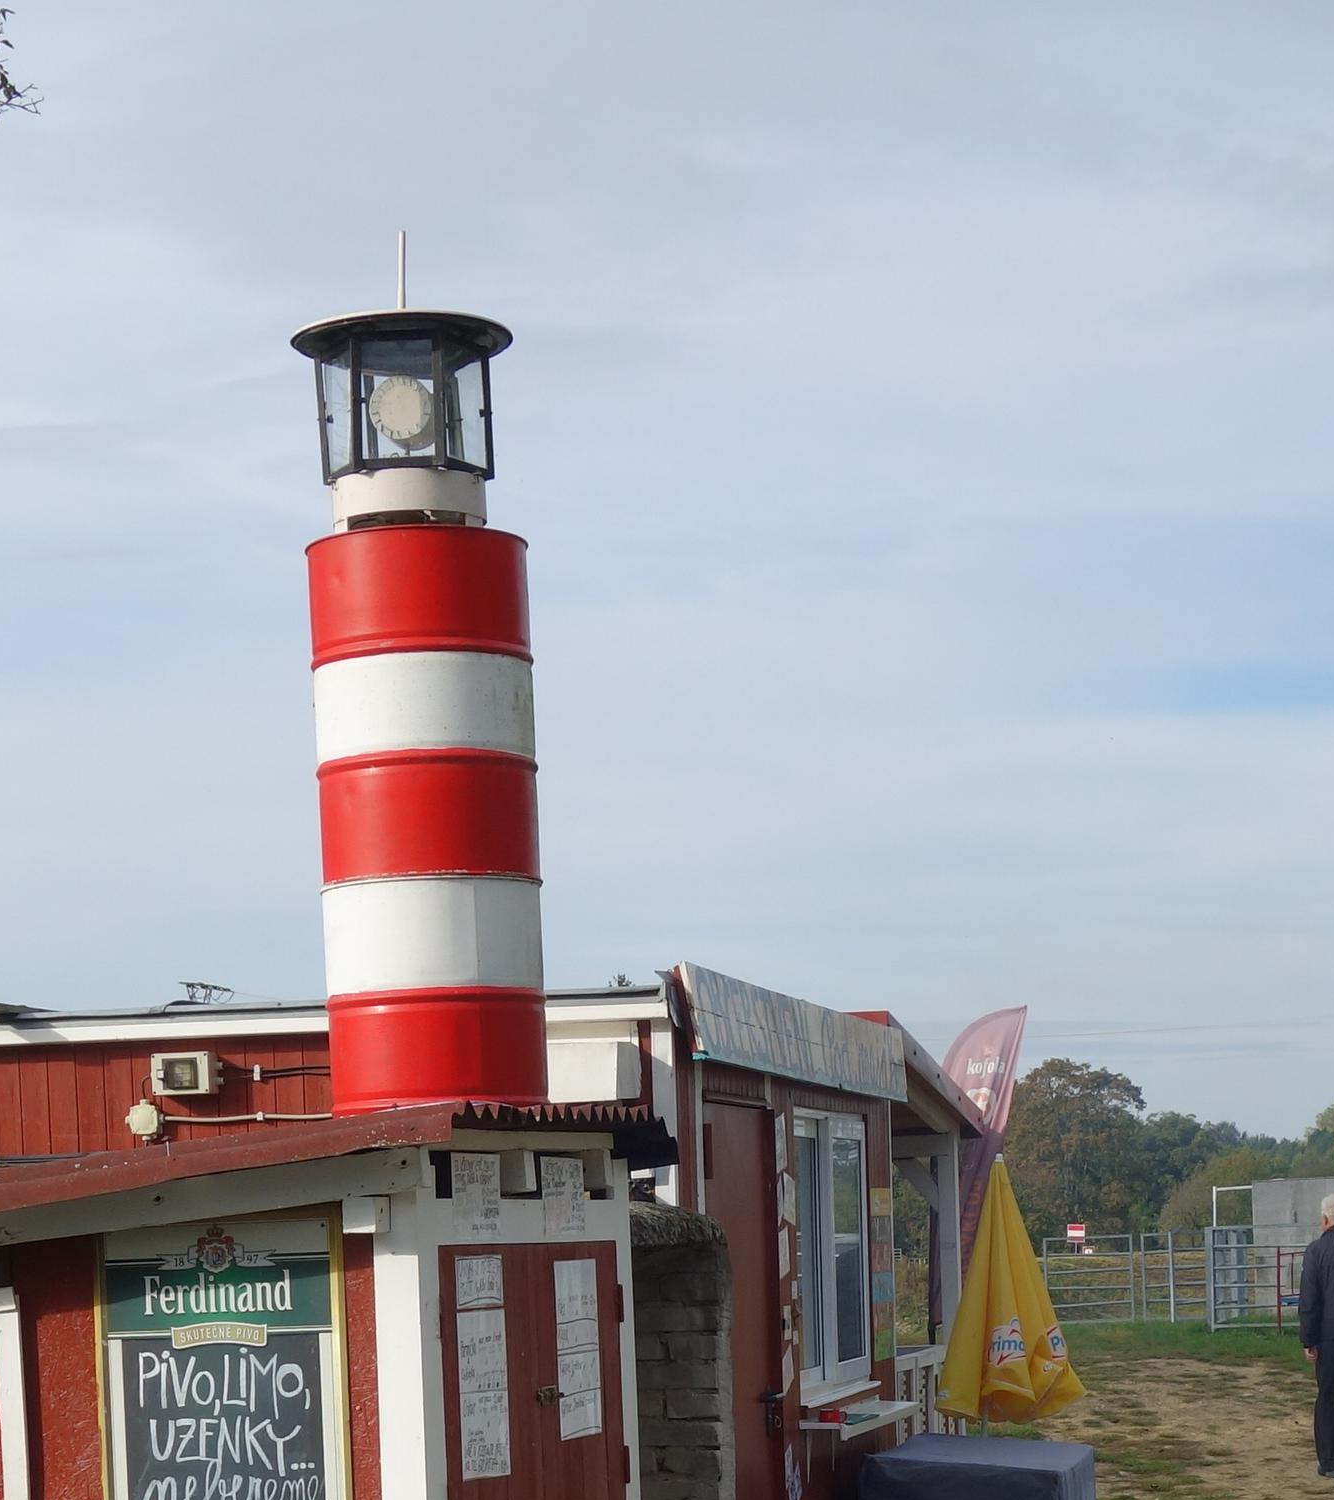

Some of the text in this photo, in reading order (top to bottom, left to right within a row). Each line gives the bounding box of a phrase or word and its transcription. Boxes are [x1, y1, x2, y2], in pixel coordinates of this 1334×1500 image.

[967, 1055, 1006, 1079] kofola
[173, 1253, 260, 1268] 18 97
[143, 1268, 294, 1317] Ferdinand
[235, 1327, 260, 1342] PIVO
